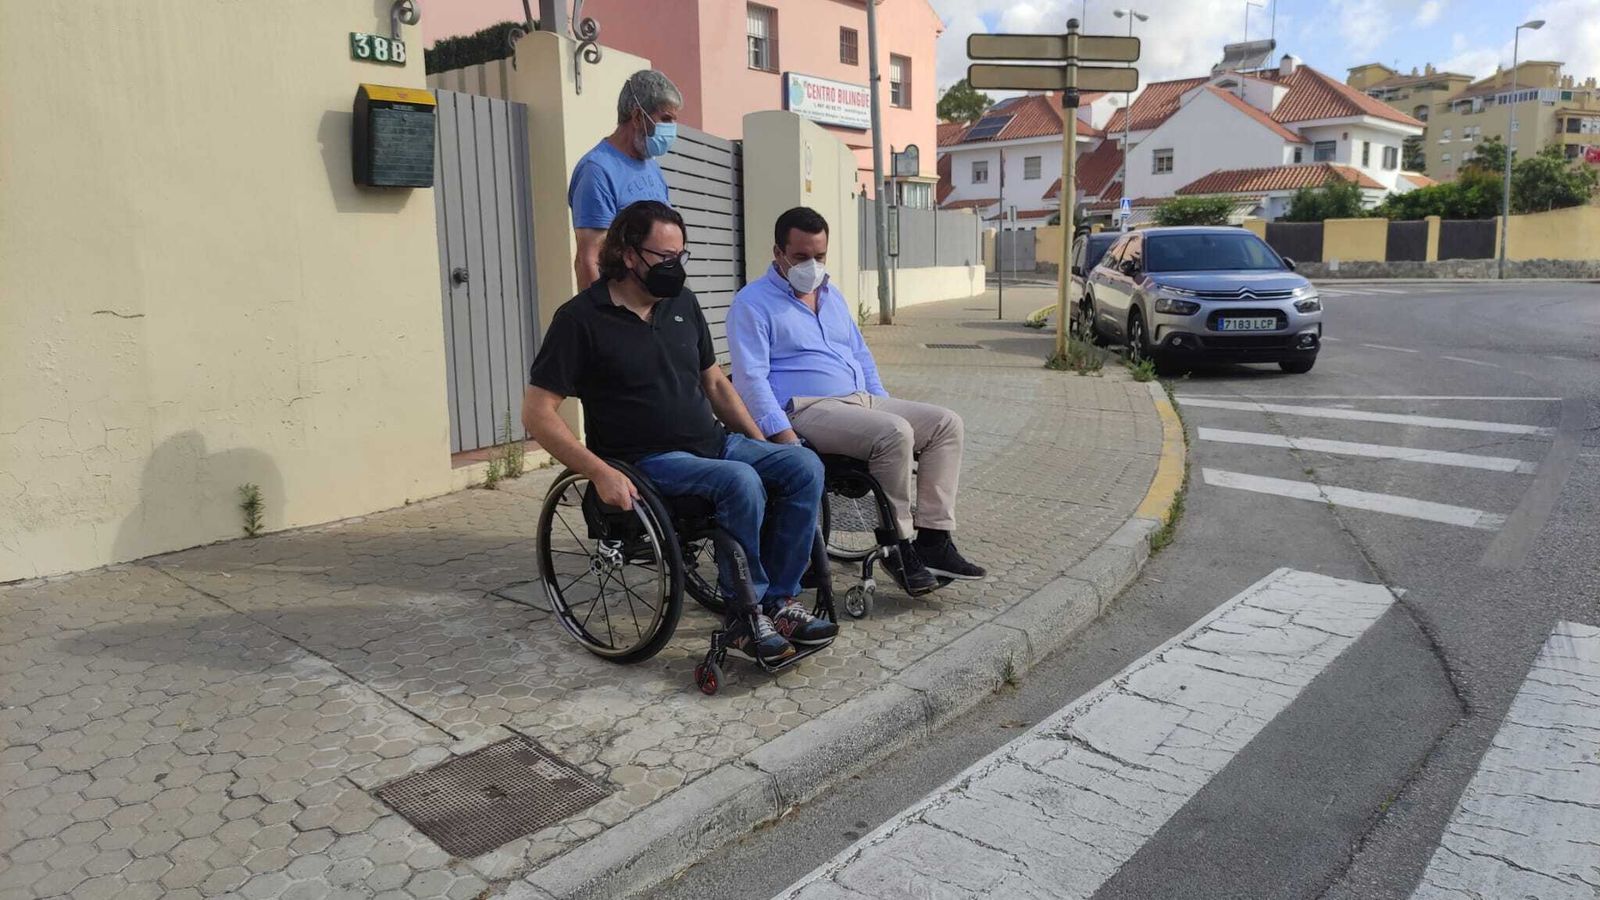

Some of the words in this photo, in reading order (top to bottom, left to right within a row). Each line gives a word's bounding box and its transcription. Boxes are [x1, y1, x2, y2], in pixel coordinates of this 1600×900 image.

[355, 32, 406, 63] 38B
[806, 82, 836, 103] CENTRO
[1225, 319, 1251, 329] 7183
[1253, 319, 1274, 329] LCP
